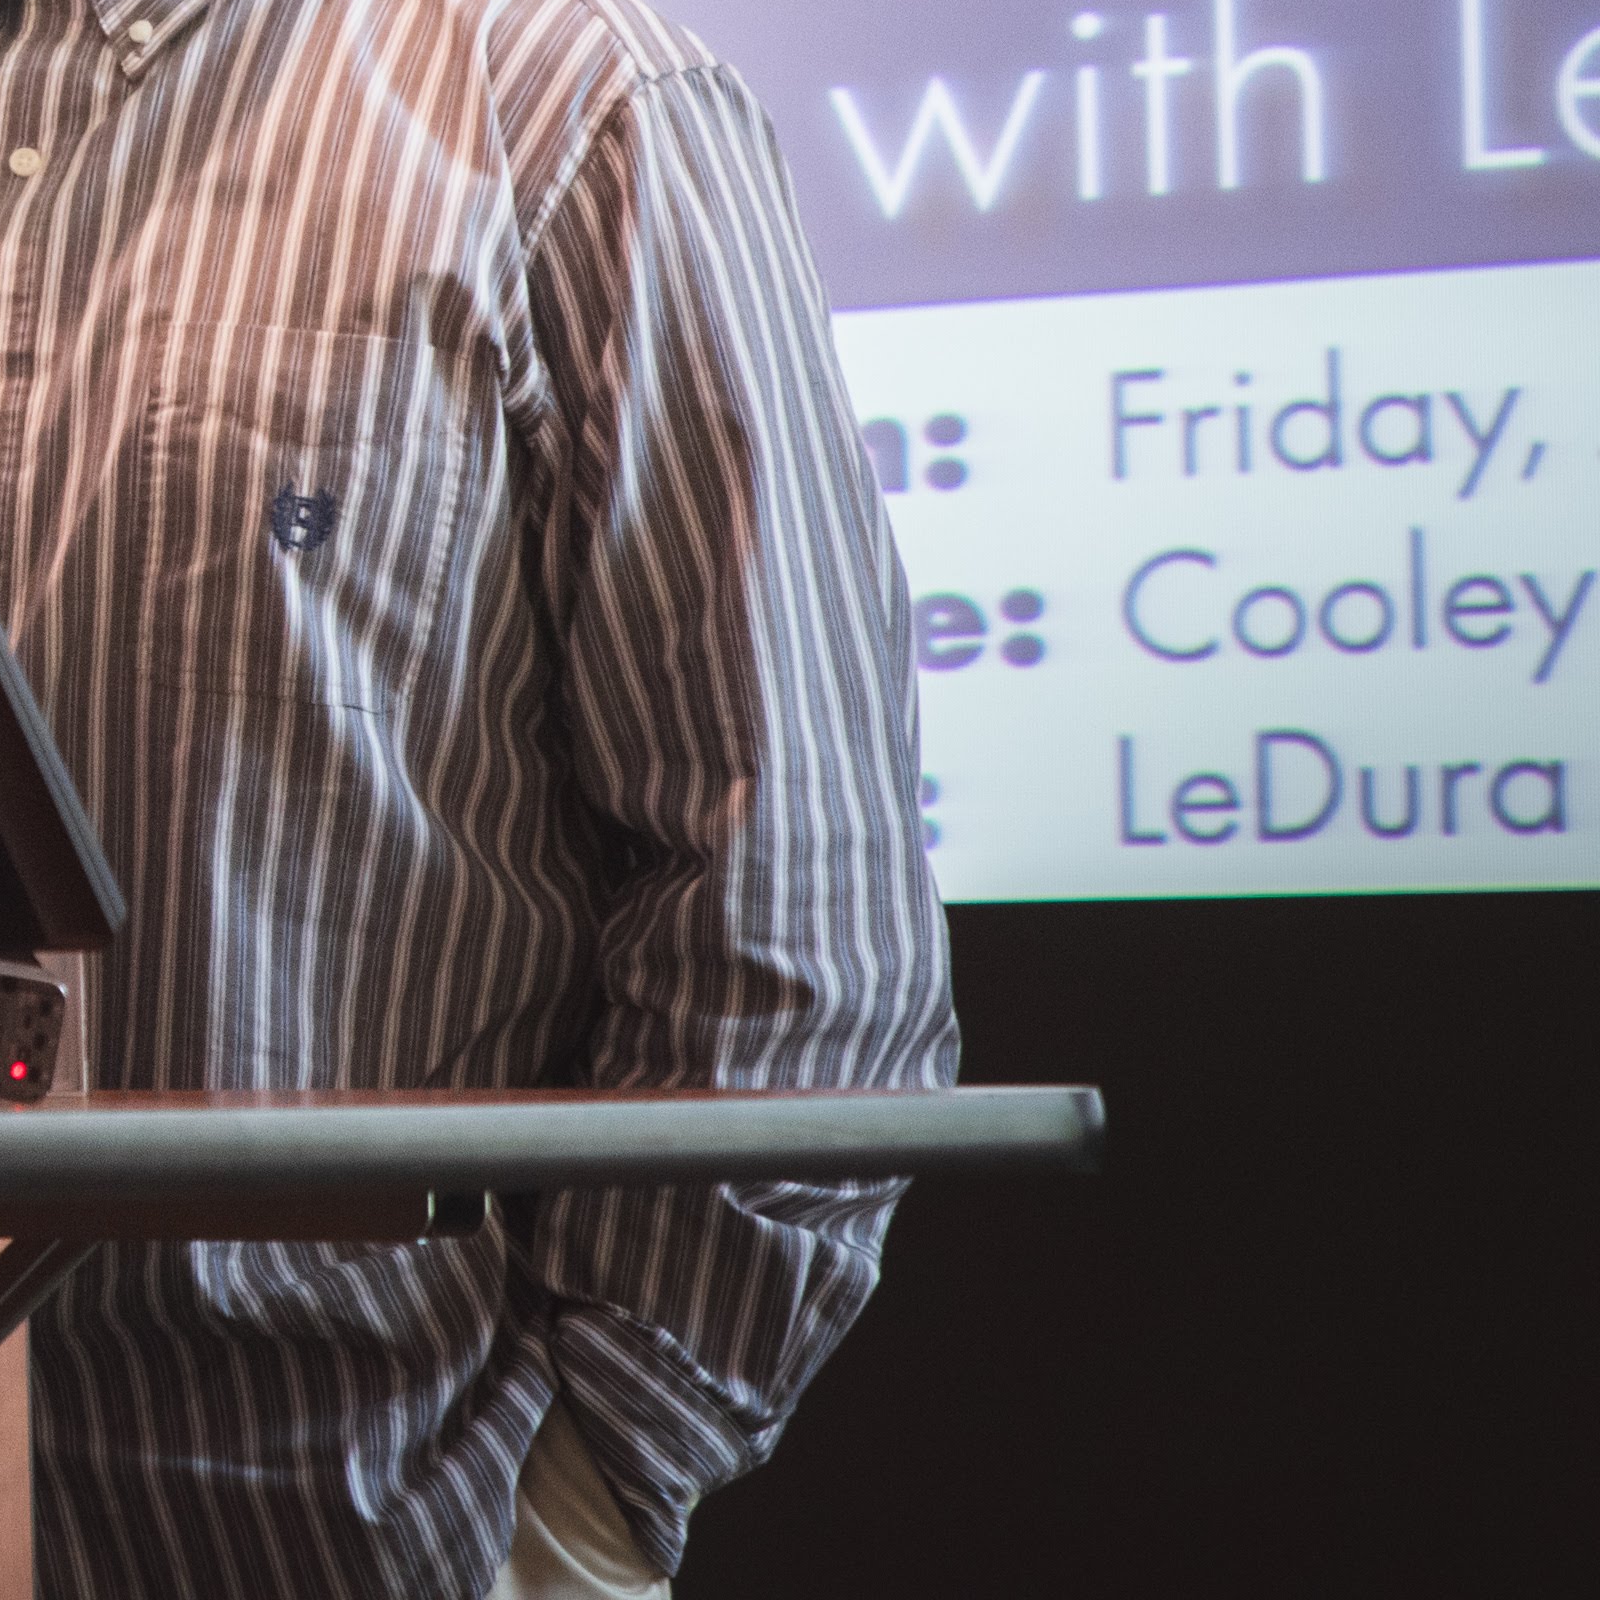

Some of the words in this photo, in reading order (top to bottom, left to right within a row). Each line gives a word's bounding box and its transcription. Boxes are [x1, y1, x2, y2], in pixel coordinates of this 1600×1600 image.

[1108, 346, 1547, 501] Friday,
[1122, 526, 1599, 685] Cooley
[1116, 727, 1567, 848] LeDura
